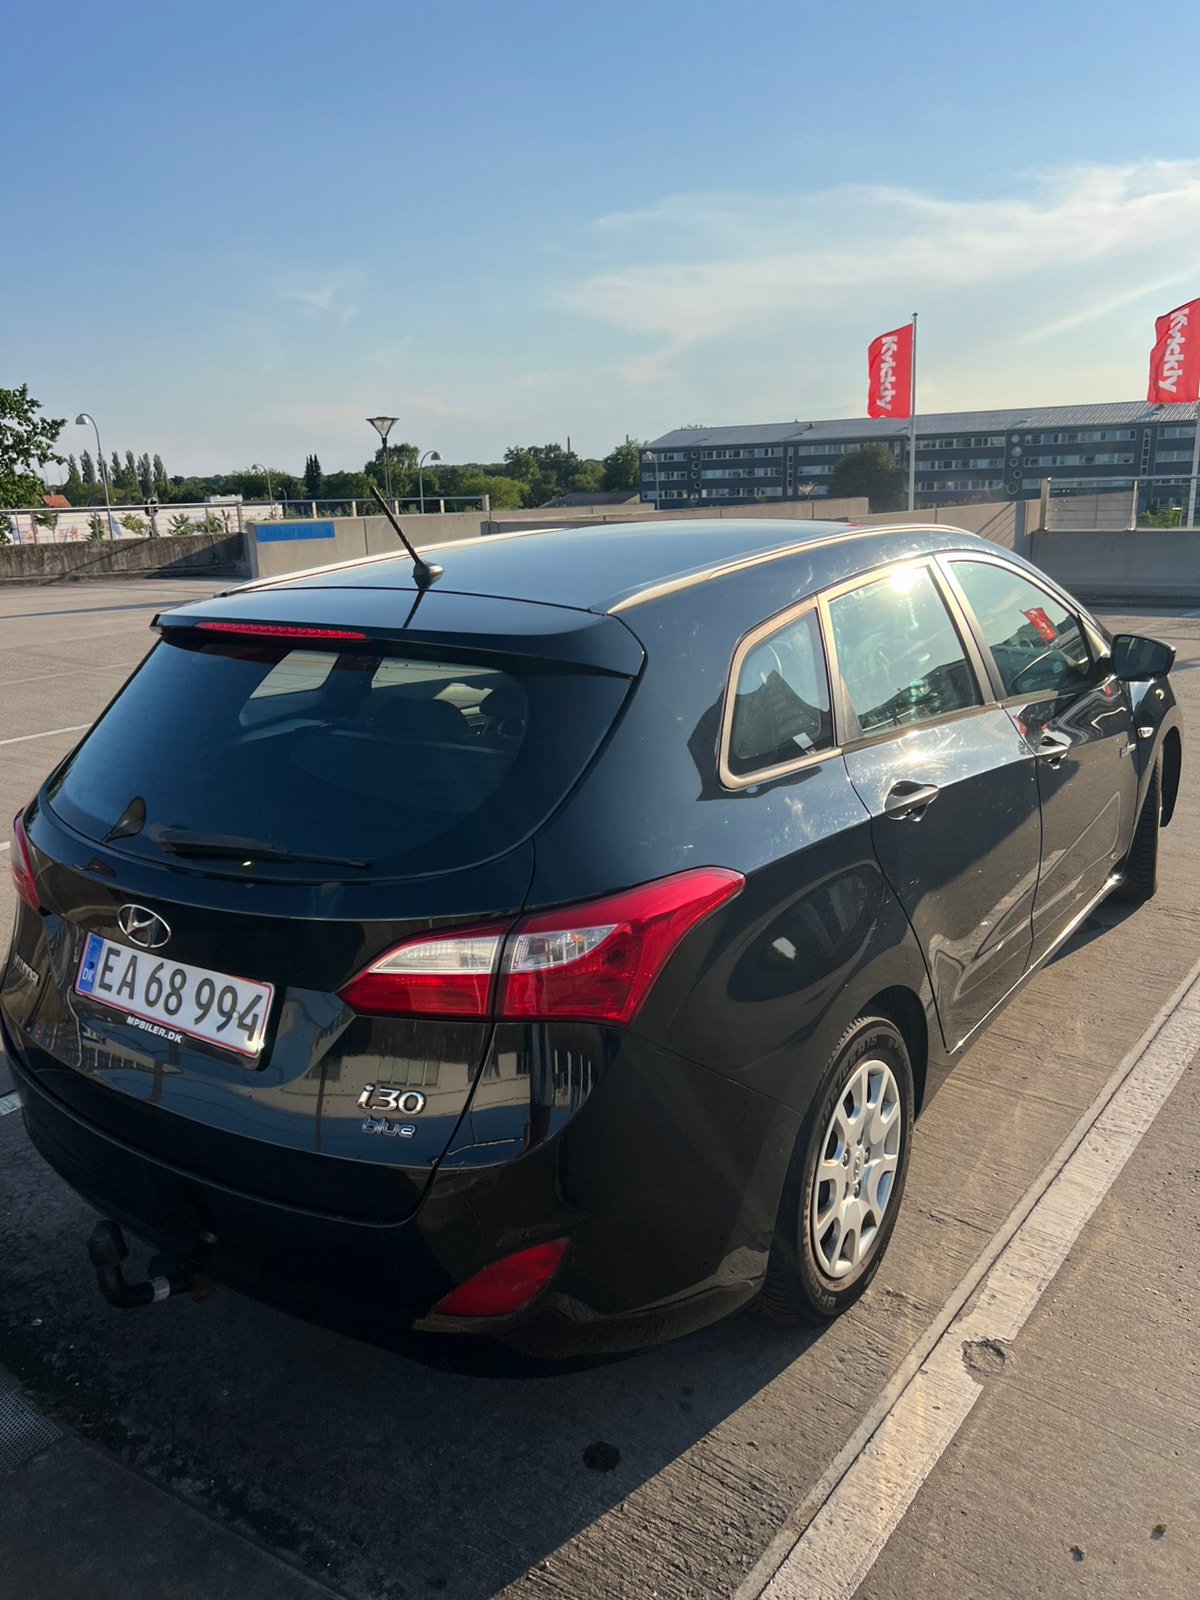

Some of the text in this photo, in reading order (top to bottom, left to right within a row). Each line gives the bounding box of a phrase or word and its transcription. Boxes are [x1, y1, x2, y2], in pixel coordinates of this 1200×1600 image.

[1158, 308, 1190, 393] Kvickly
[876, 335, 898, 411] Kvickly
[82, 967, 95, 983] DK
[98, 947, 263, 1042] EA 68 994
[126, 1016, 183, 1043] MPBILER.DK
[357, 1083, 426, 1115] i30
[361, 1115, 416, 1138] blue
